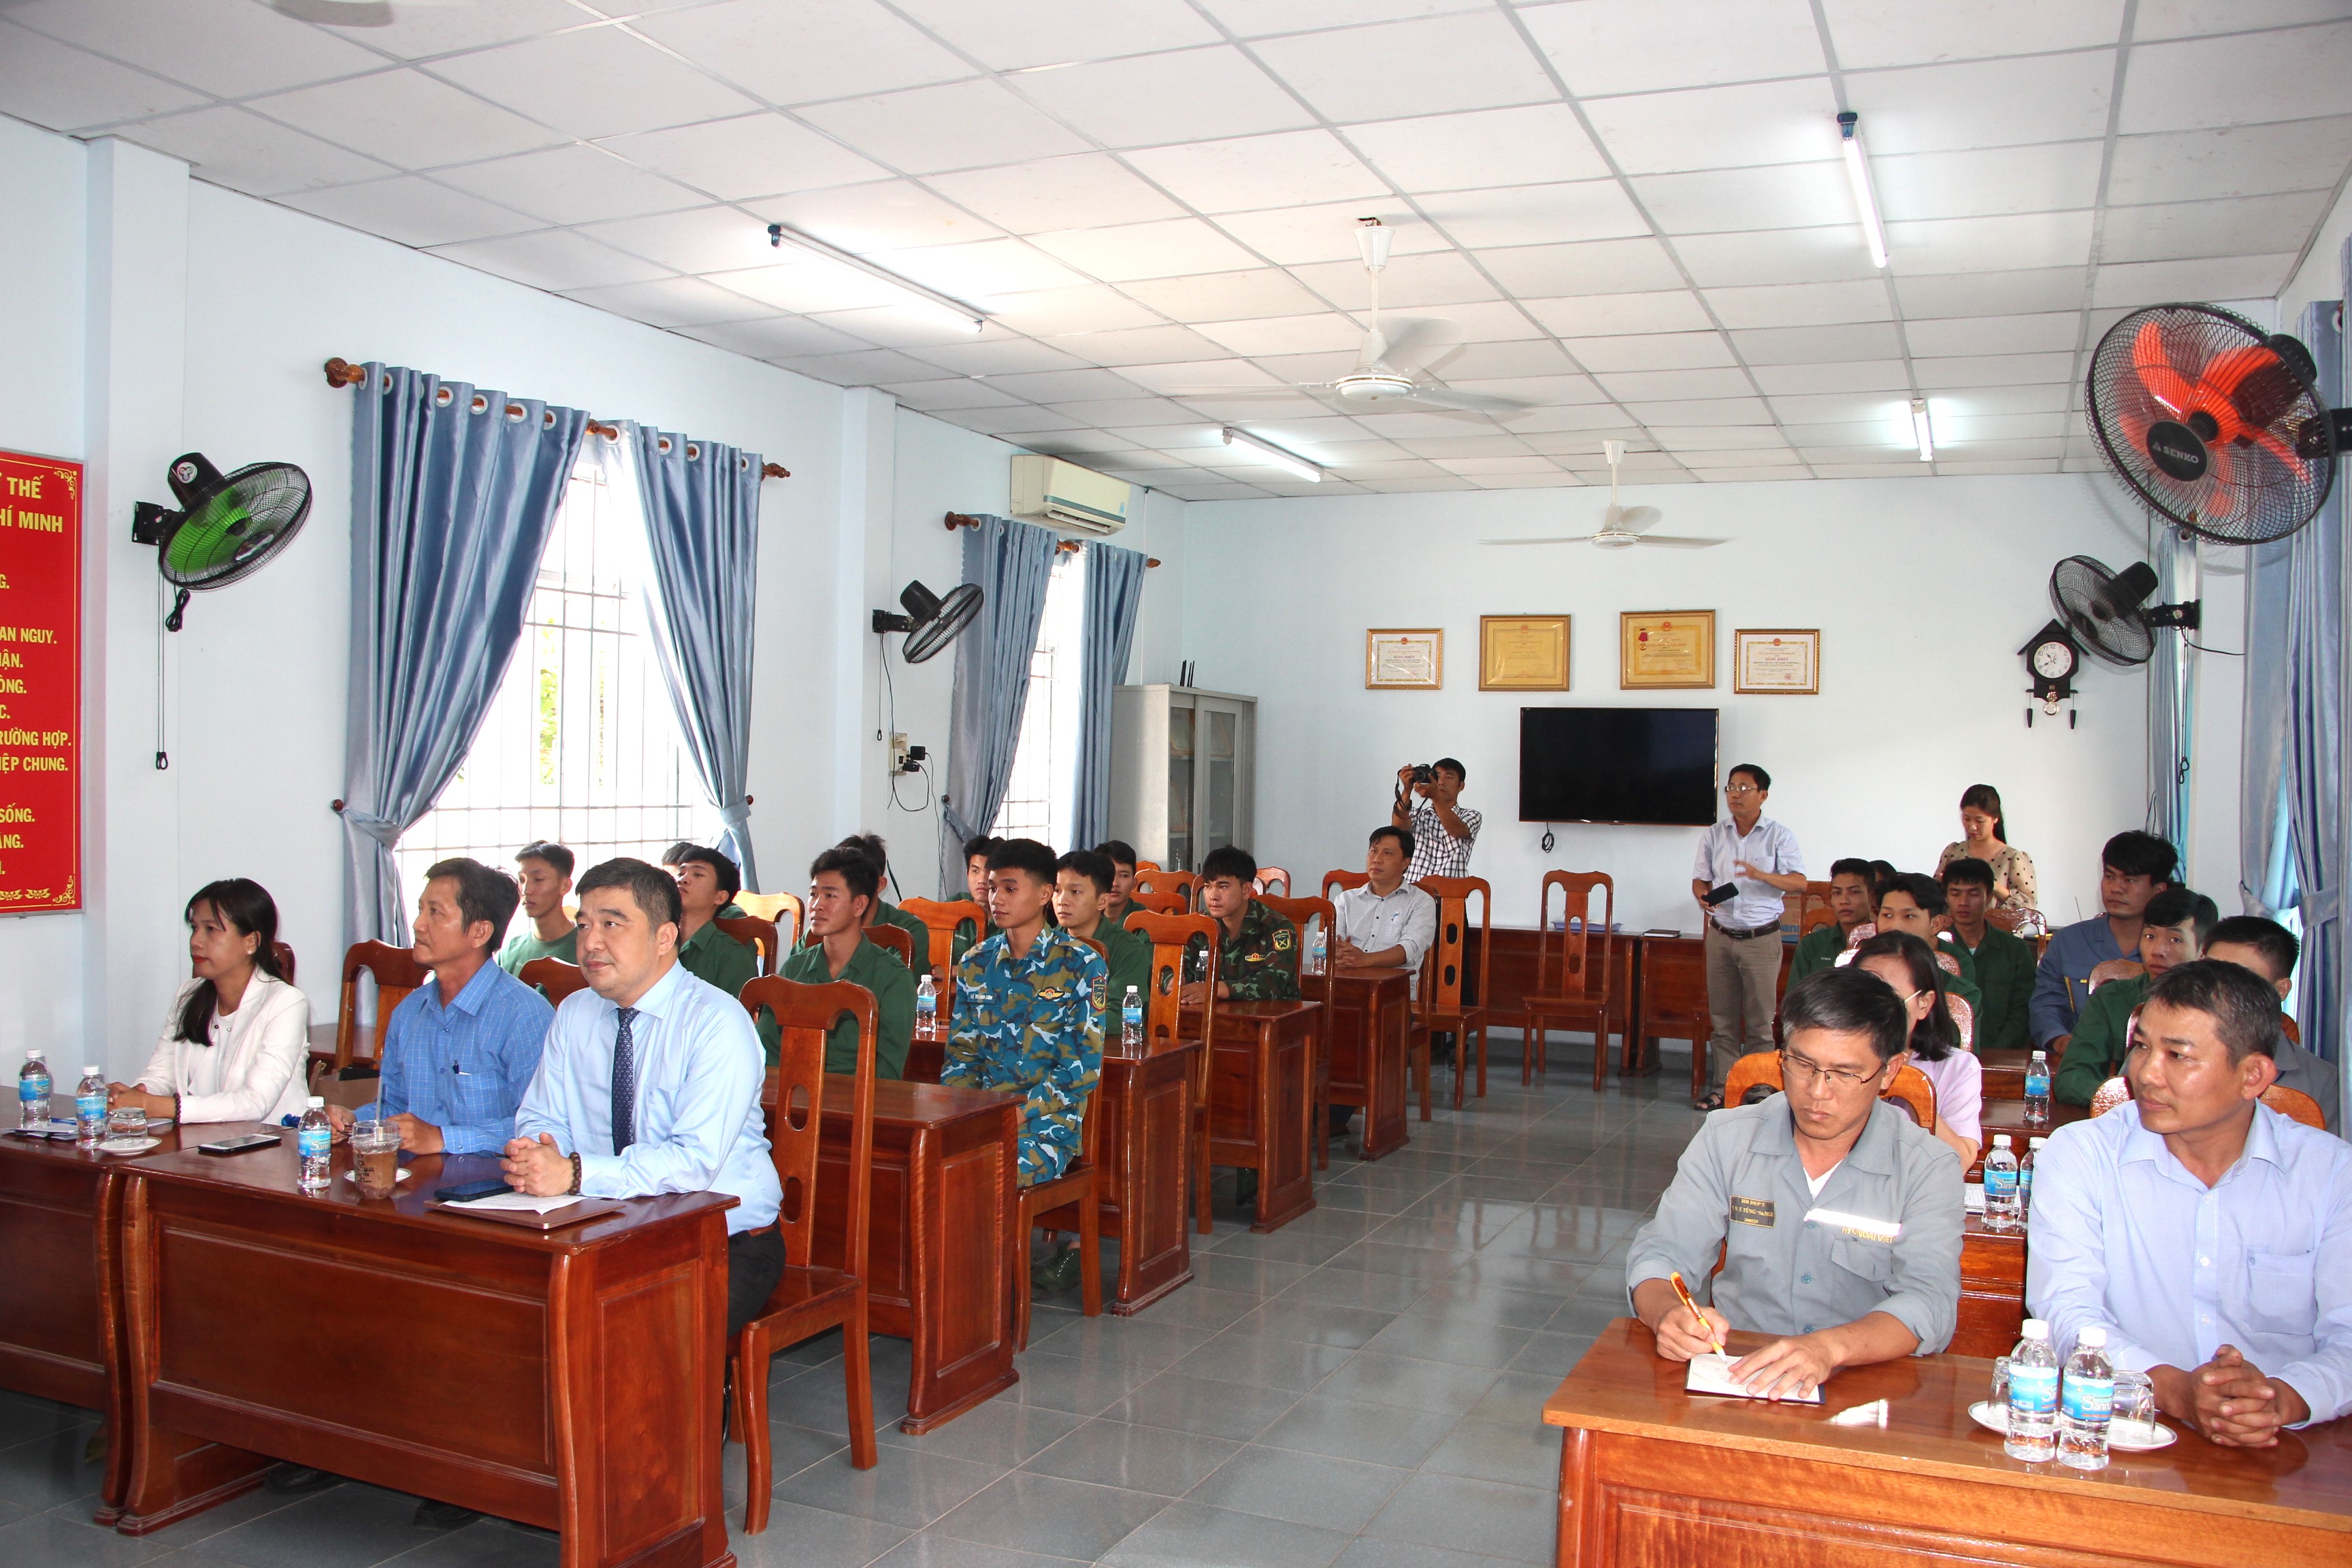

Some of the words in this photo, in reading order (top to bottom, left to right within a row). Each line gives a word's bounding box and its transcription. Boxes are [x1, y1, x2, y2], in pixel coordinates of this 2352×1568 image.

[2163, 446, 2199, 464] SENKO
[18, 510, 63, 533] MINH
[20, 627, 57, 644] NGUY.
[42, 730, 71, 749] HỢP.
[22, 757, 69, 771] CHUNG.
[1842, 1226, 1876, 1241] HYUNDAI
